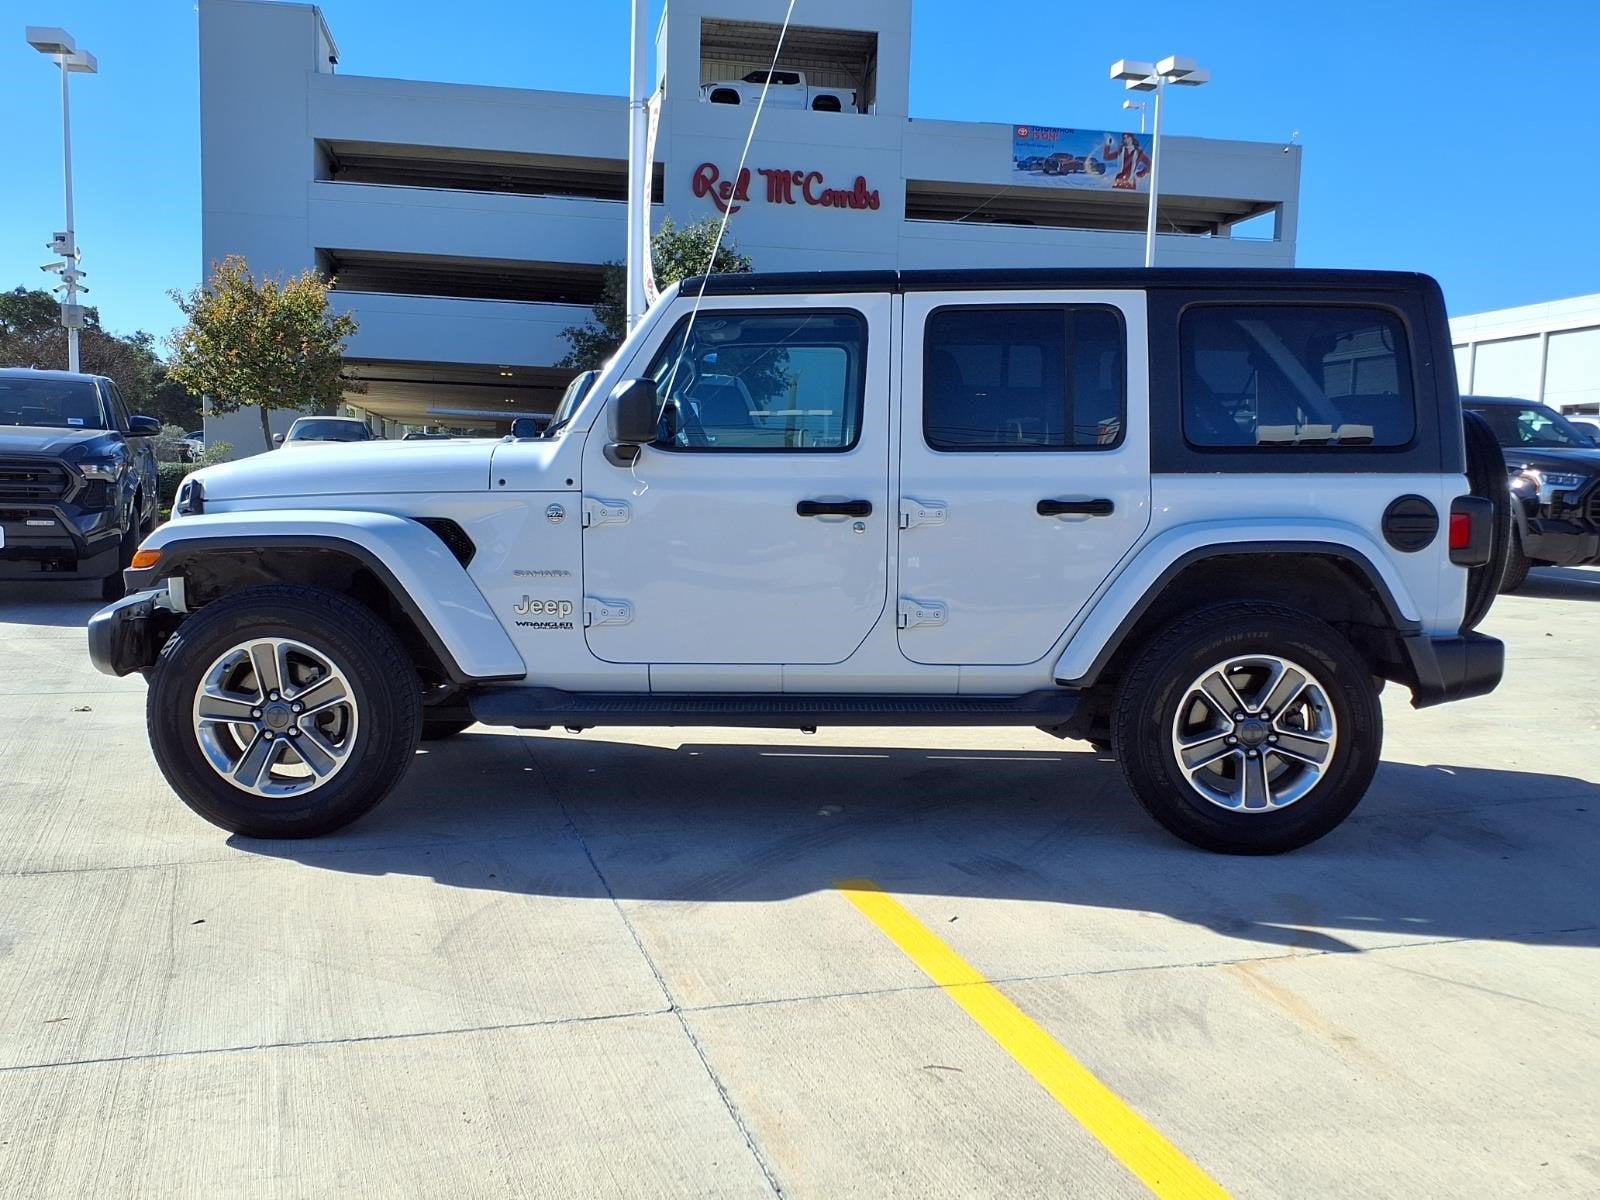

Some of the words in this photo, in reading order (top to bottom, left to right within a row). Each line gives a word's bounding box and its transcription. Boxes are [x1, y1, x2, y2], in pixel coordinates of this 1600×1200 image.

[693, 163, 750, 214] Red
[757, 168, 880, 210] McCombs
[513, 594, 573, 619] Jeep
